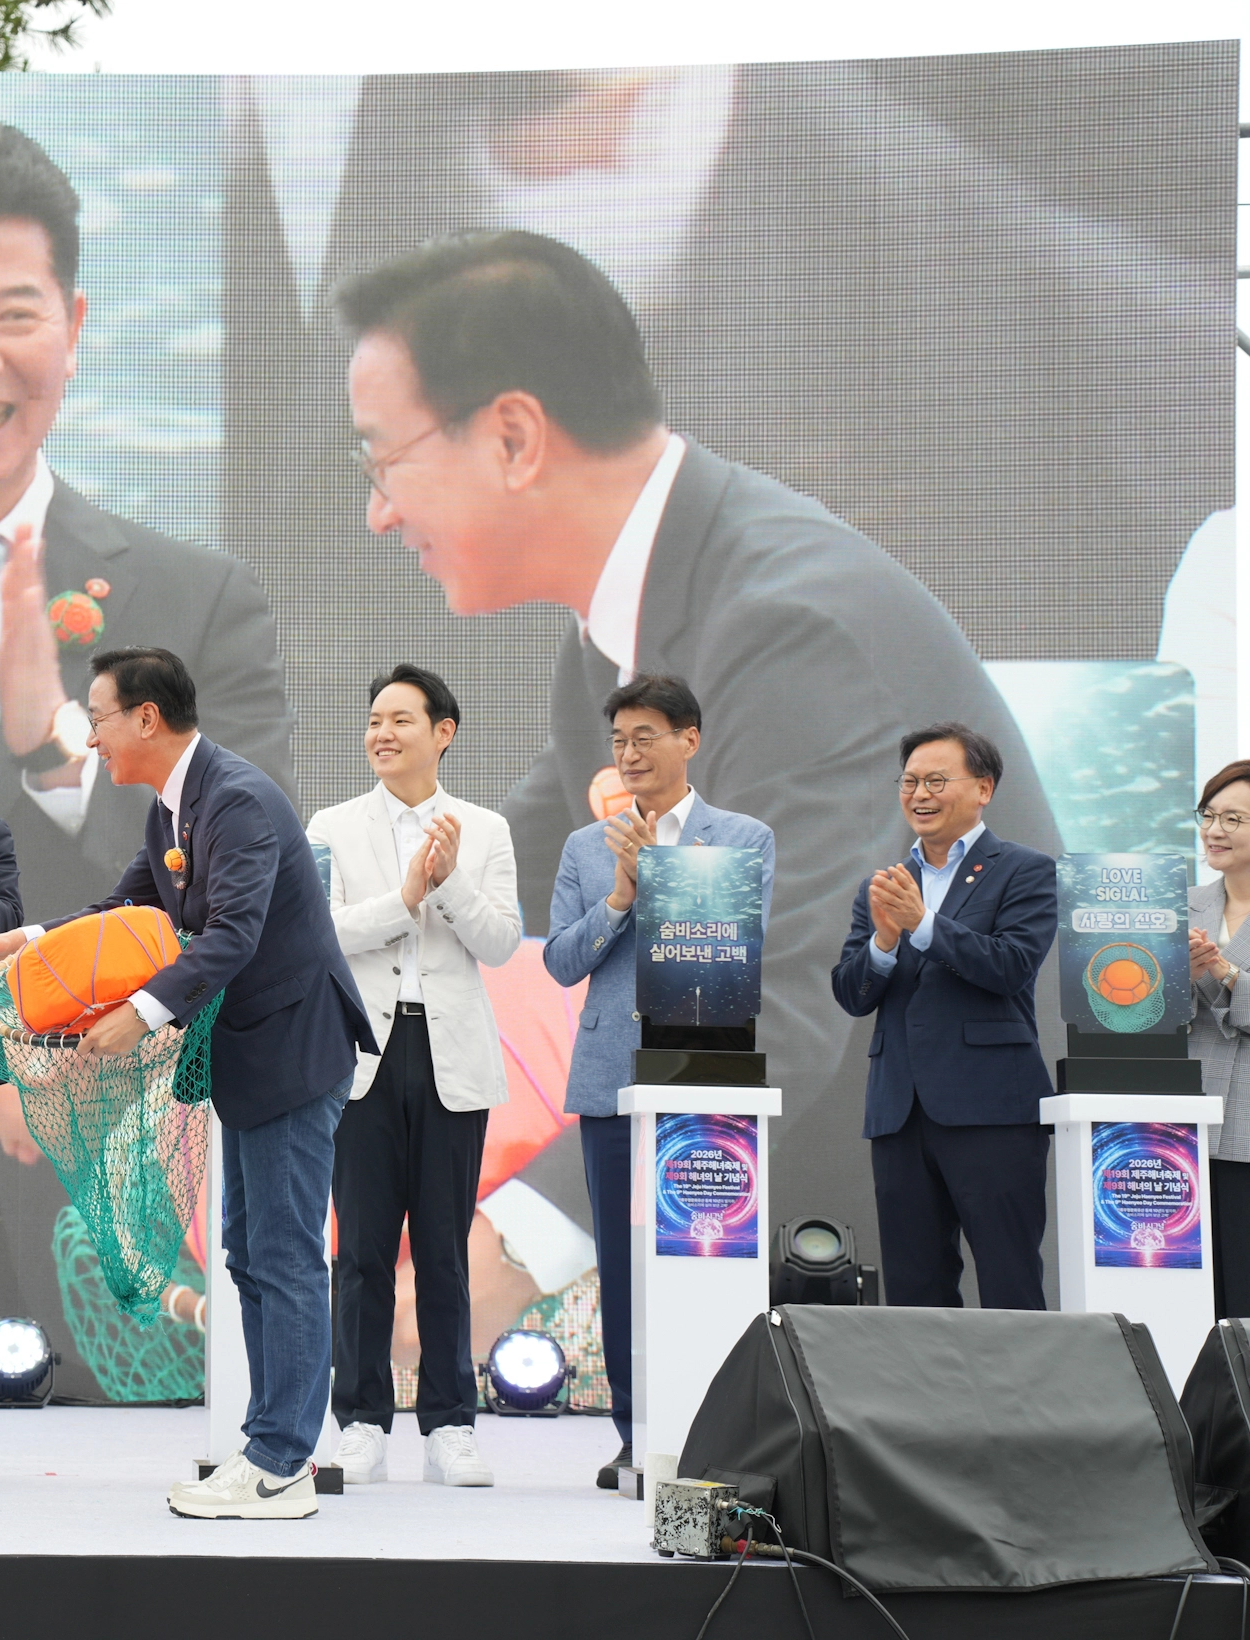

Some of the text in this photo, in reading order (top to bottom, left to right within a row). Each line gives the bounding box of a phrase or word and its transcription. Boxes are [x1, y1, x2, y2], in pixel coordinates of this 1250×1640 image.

[1102, 868, 1142, 884] LOVE
[1096, 886, 1149, 902] SIGLAL
[1079, 912, 1167, 929] 사랑의 신호
[659, 921, 738, 941] 숨비소리에
[649, 943, 747, 964] 실어보낸 고백
[691, 1150, 723, 1159] 2026년
[665, 1160, 691, 1169] 제19회
[692, 1160, 740, 1171] 제주해녀축제
[1129, 1159, 1162, 1168] 2026년
[665, 1172, 748, 1183] 제9회 해녀의 날 기념식
[1102, 1169, 1129, 1179] 제19회
[1131, 1170, 1180, 1179] 제주해녀축제
[1103, 1181, 1189, 1192] 제9회 해녀의 날 기념식
